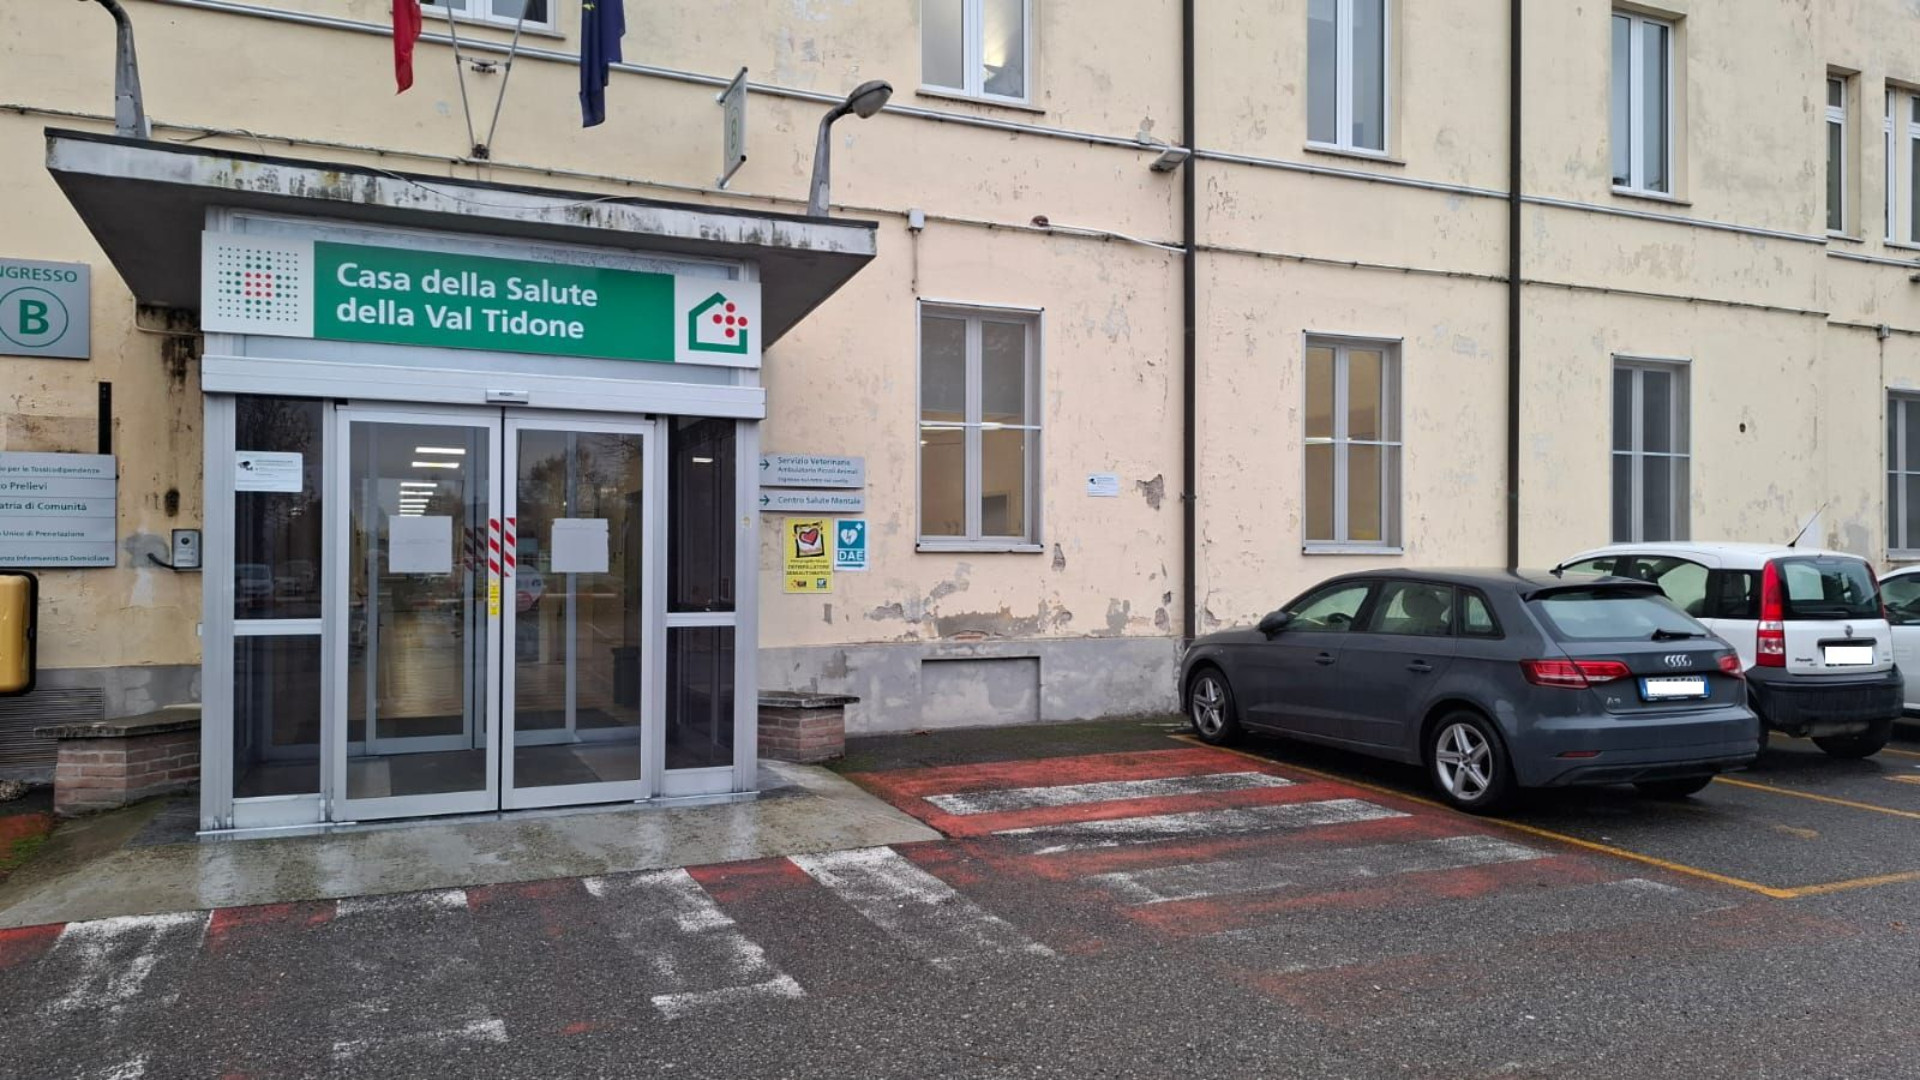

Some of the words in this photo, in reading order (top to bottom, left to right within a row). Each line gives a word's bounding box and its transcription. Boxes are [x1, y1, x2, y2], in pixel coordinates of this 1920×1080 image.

[336, 262, 411, 291] Casa
[421, 268, 496, 298] della
[506, 276, 598, 307] Salute
[19, 299, 49, 334] B
[336, 297, 415, 326] della
[425, 304, 473, 330] Val
[481, 308, 585, 339] Tidone
[778, 456, 809, 465] Servizio
[10, 481, 48, 491] Prelievi
[778, 496, 805, 504] Centro
[806, 496, 830, 505] Salute
[831, 496, 861, 505] Mentale
[25, 501, 34, 510] di
[37, 501, 88, 511] Comunità
[36, 530, 85, 538] Prenotazione
[839, 551, 864, 560] DAE
